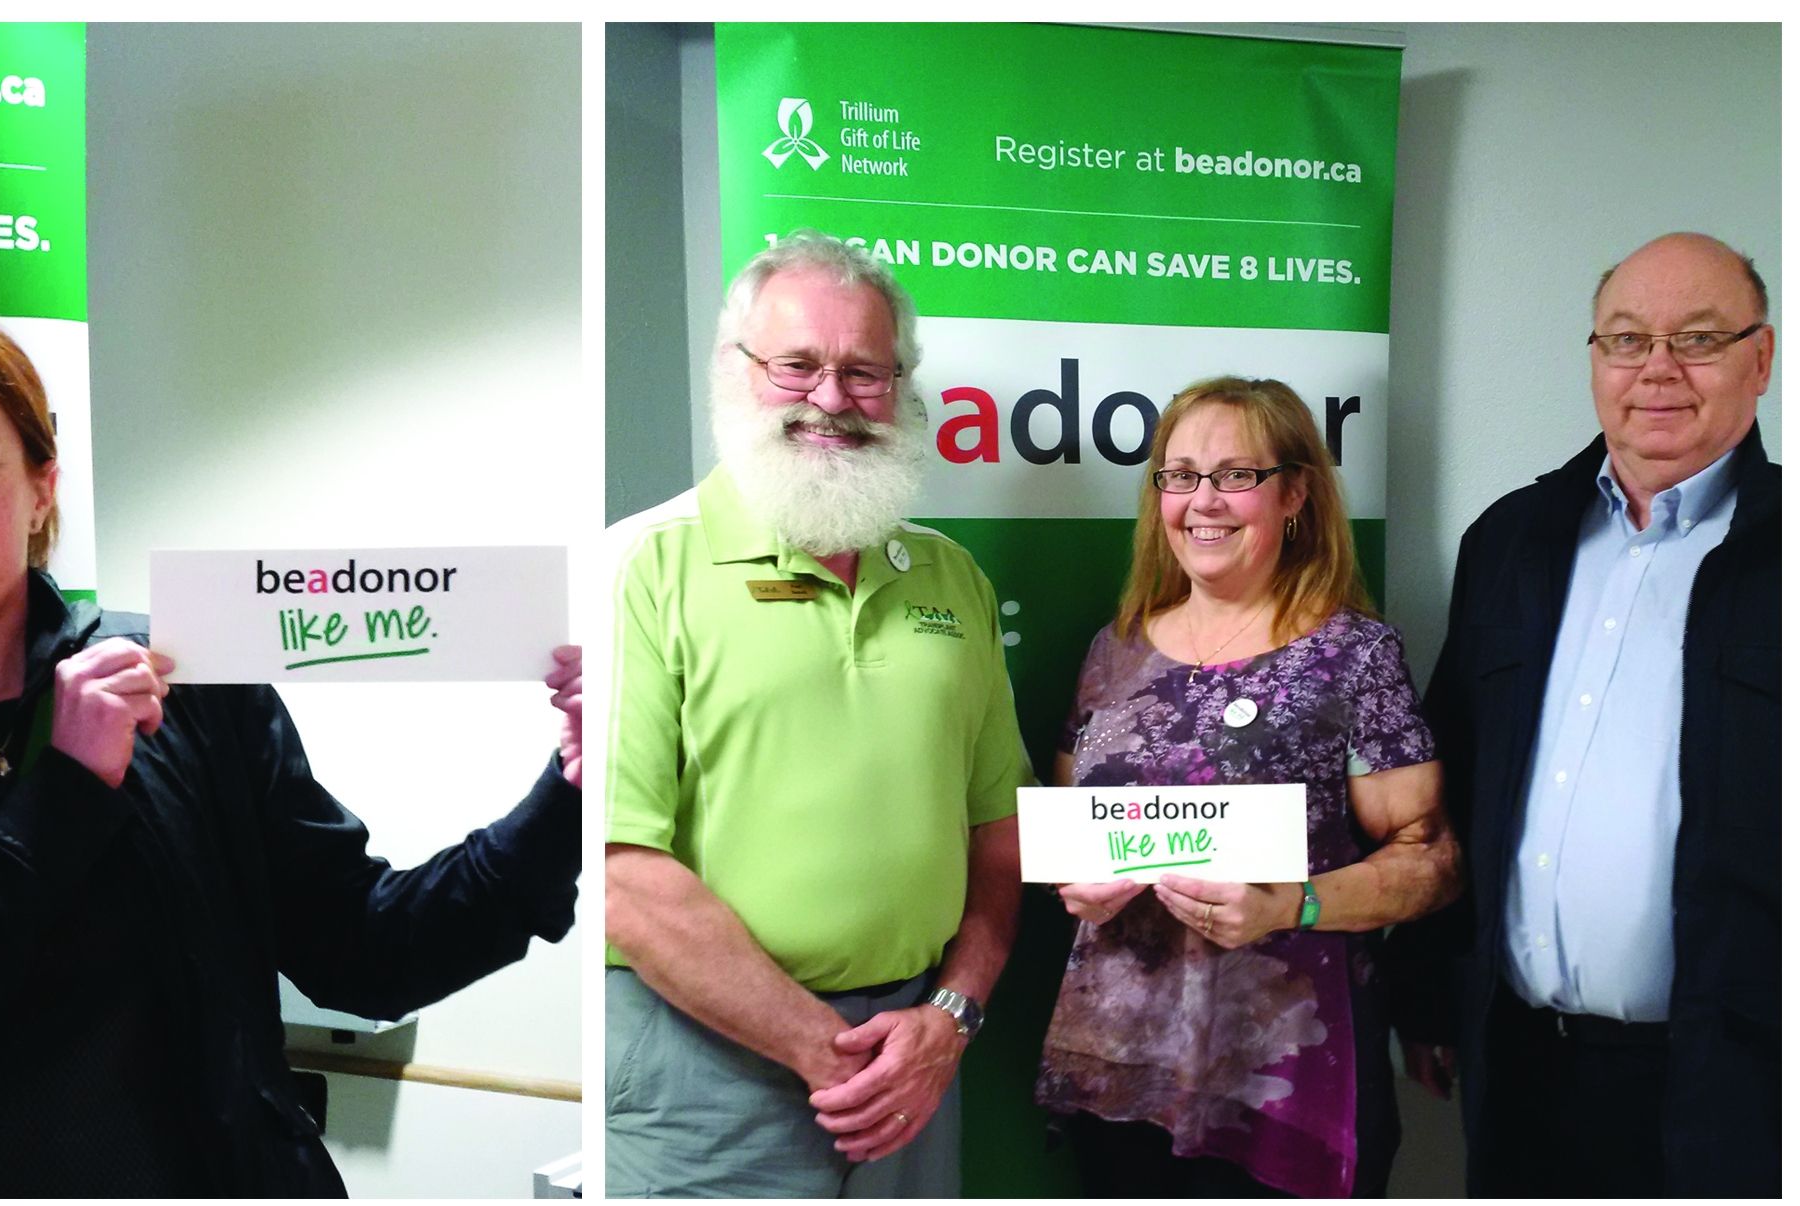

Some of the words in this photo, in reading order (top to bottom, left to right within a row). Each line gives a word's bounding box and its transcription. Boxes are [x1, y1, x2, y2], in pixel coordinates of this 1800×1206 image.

[839, 100, 899, 123] Trillium
[840, 127, 869, 148] Gift
[872, 129, 890, 149] of
[892, 130, 920, 151] Life
[841, 153, 908, 177] Network
[995, 136, 1126, 174] Register
[1136, 147, 1165, 173] at
[1175, 147, 1362, 183] beadonor.ca
[932, 241, 1058, 272] DONOR
[1068, 247, 1137, 275] CAN
[1146, 251, 1230, 279] SAVE
[1240, 254, 1259, 279] 8
[1268, 256, 1361, 285] LIVES.
[256, 559, 457, 594] beadonor
[279, 608, 348, 652] like
[364, 605, 438, 643] me.
[1091, 795, 1230, 820] beadonor
[1108, 831, 1155, 861] like
[1167, 828, 1217, 855] me.
